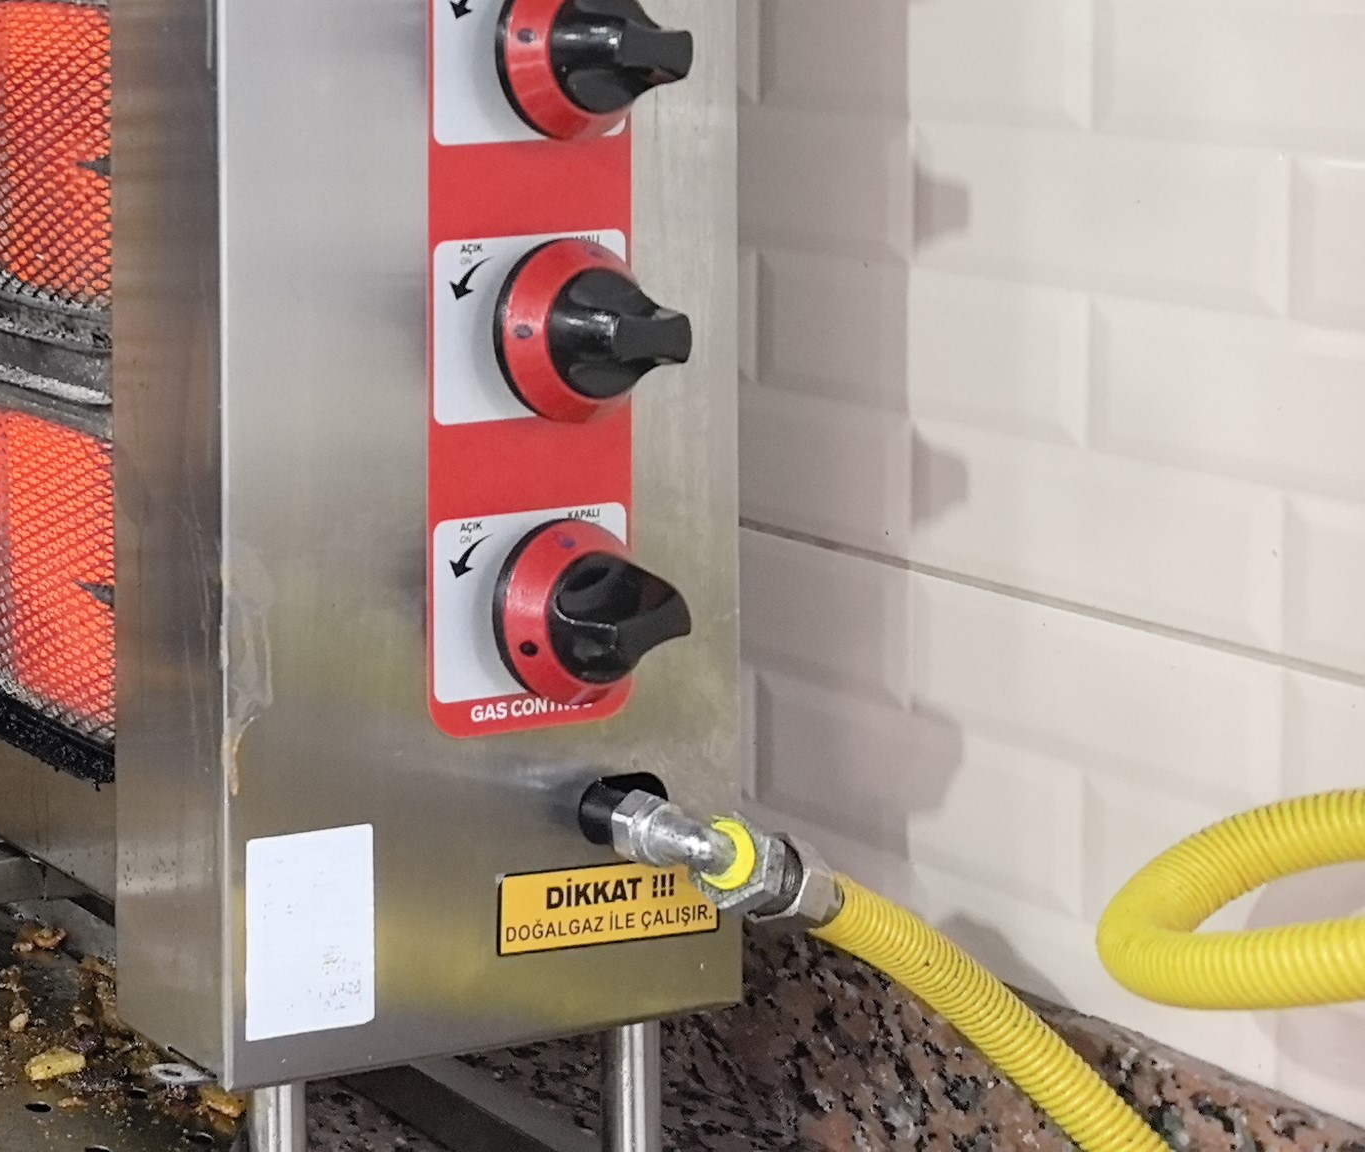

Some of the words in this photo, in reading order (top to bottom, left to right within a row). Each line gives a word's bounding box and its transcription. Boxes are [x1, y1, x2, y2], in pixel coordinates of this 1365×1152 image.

[459, 520, 484, 534] AÇIK
[470, 701, 508, 723] GAS
[545, 877, 643, 910] DİKKAT
[652, 873, 675, 898] !!!
[505, 916, 604, 943] DOĞALGAZ
[609, 911, 636, 931] İLE
[641, 904, 714, 932] ÇALIŞIR.
